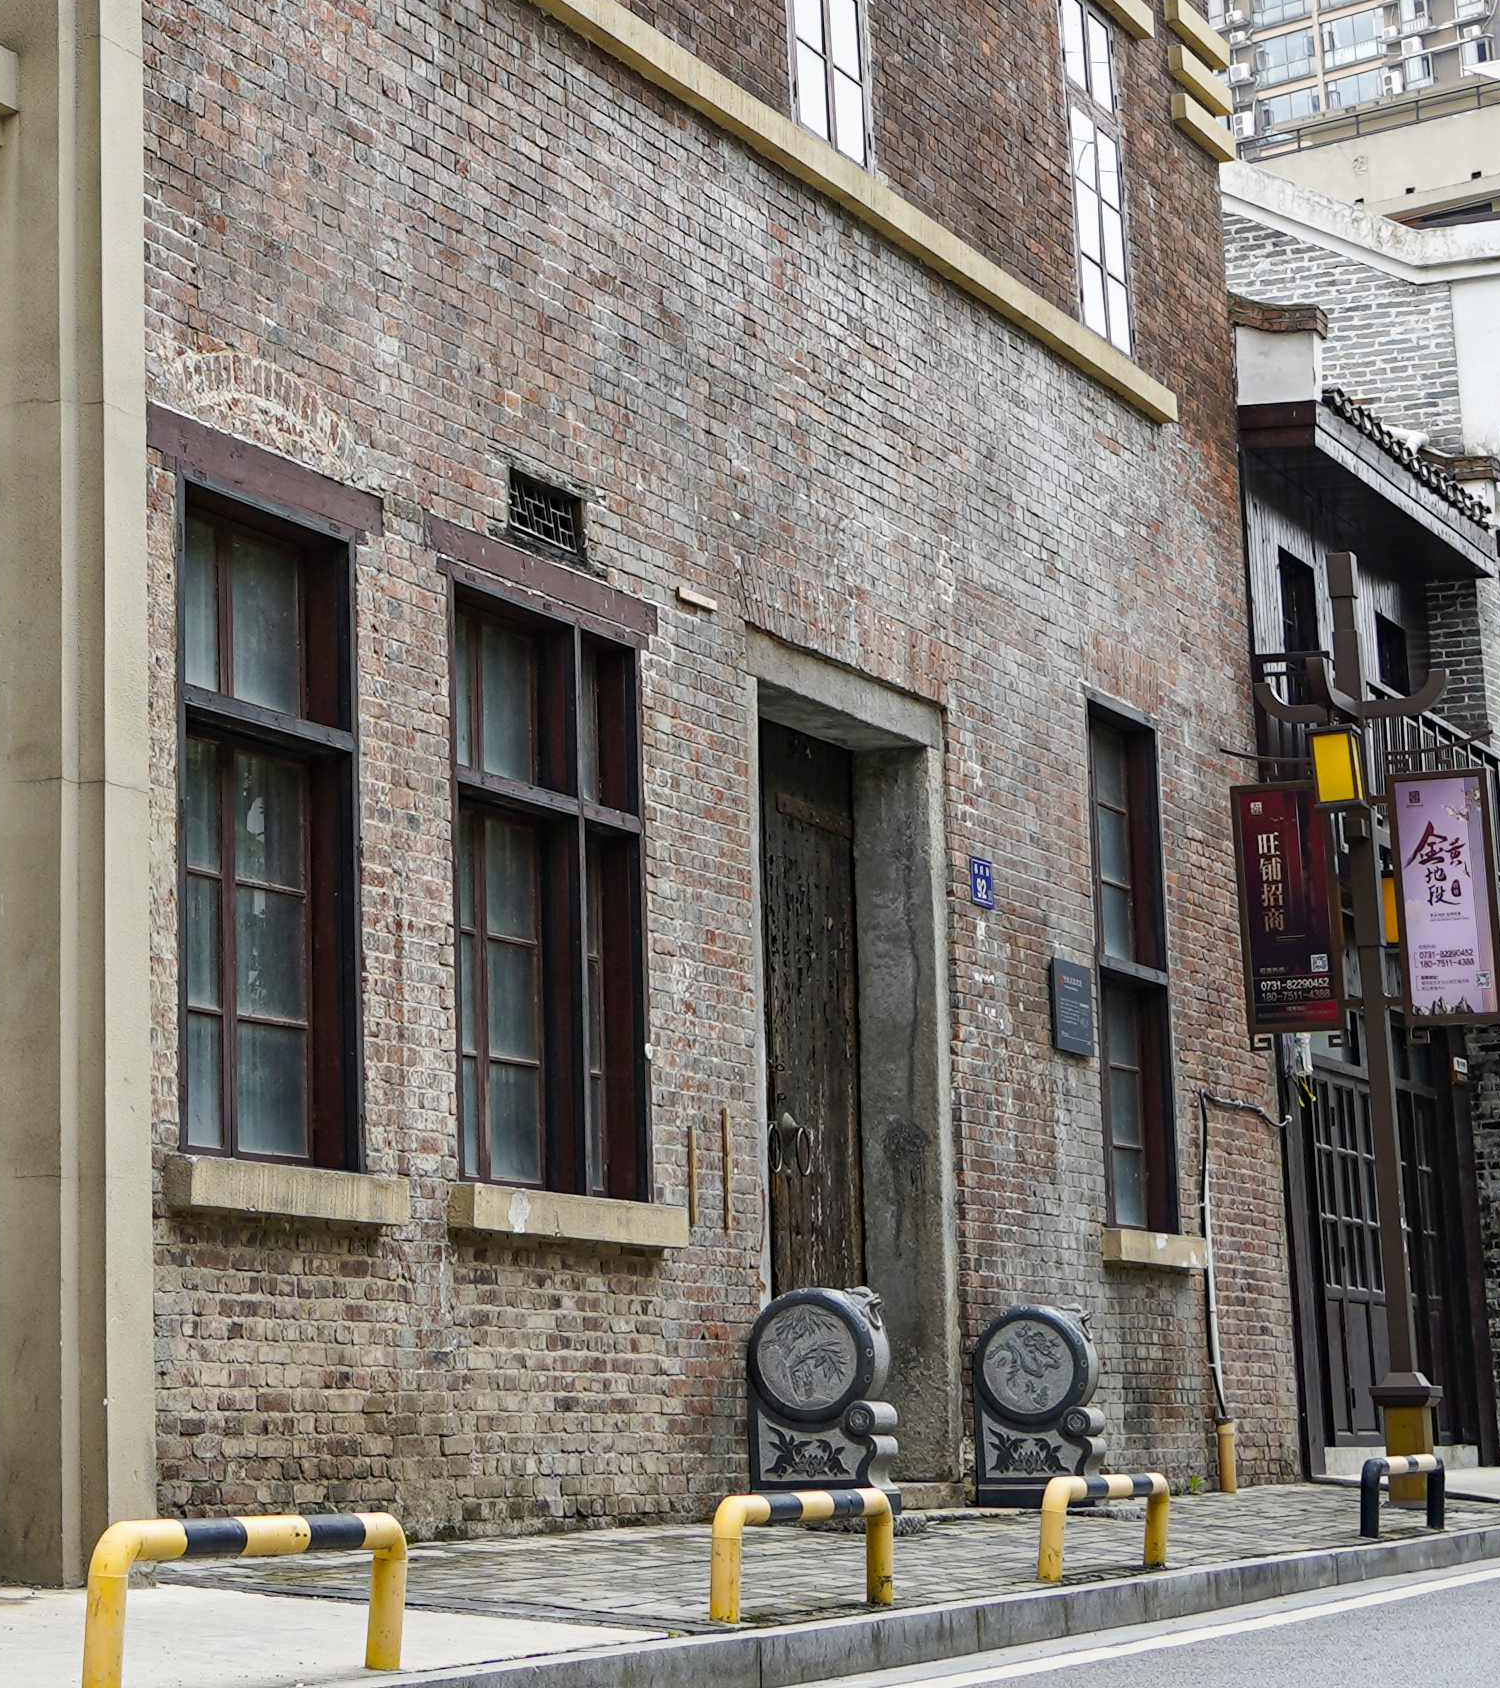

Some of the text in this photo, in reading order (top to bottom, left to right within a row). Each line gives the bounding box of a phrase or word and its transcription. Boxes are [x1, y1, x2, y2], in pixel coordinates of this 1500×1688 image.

[976, 877, 987, 900] 92
[1257, 831, 1285, 932] 旺铺招商
[1260, 977, 1330, 991] 0731-82290452
